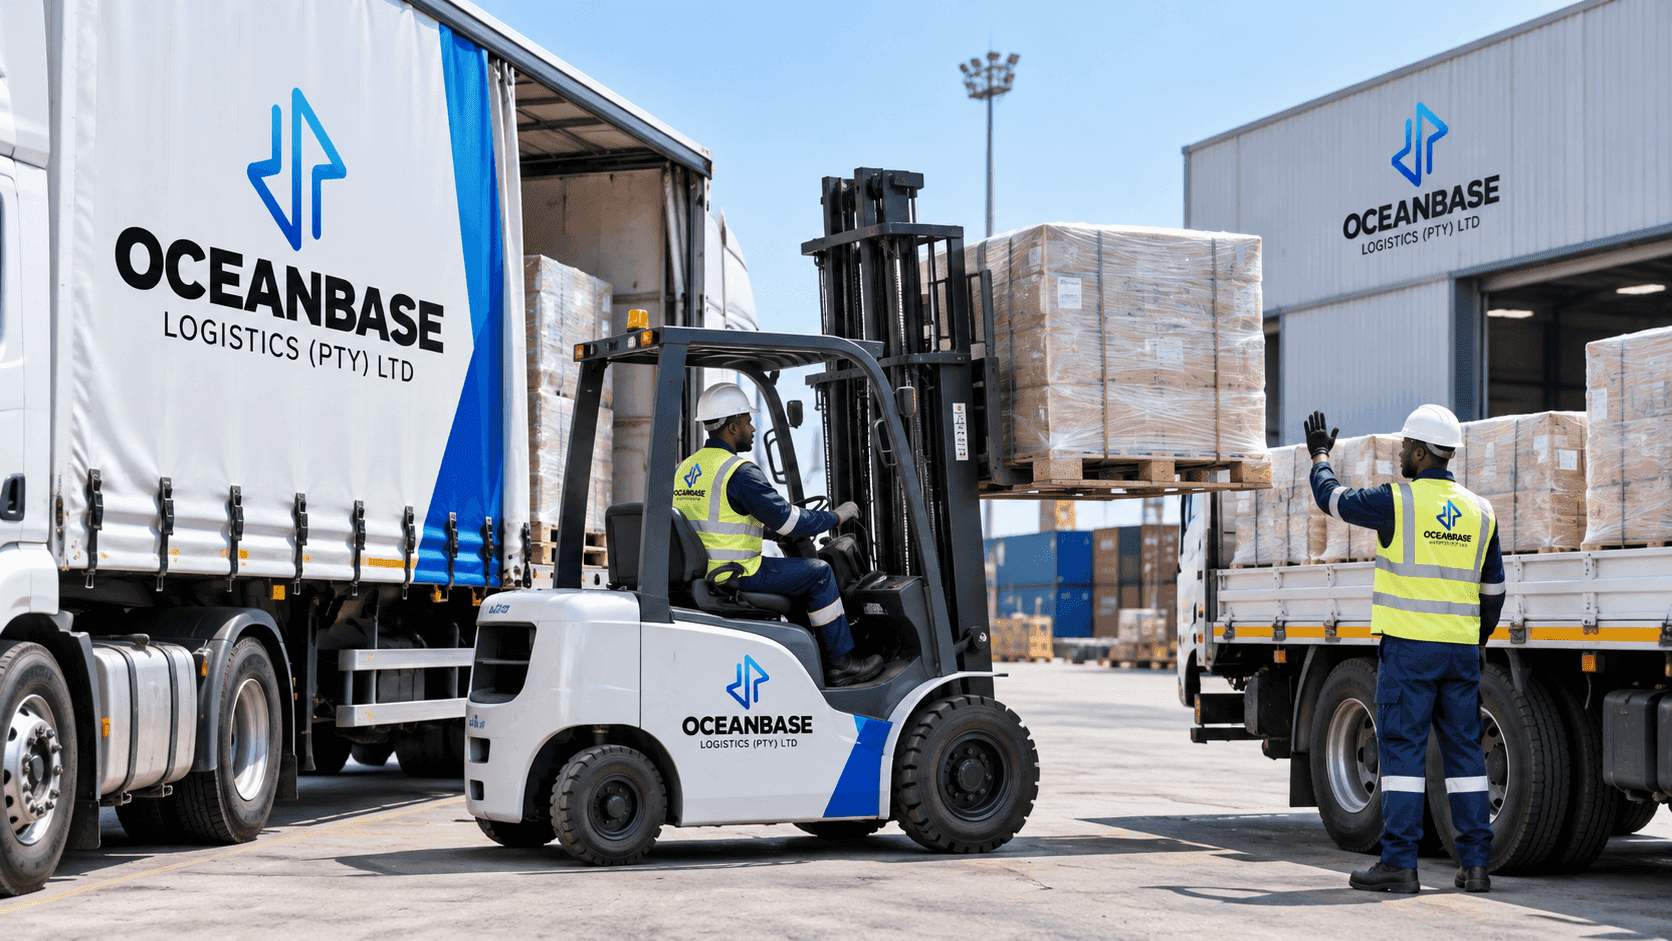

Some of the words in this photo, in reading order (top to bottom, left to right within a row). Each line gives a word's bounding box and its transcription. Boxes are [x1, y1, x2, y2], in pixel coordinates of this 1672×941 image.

[1342, 175, 1500, 240] OCEANBASE
[1361, 230, 1419, 256] LOGISTICS
[1423, 223, 1454, 242] (PTY)
[1457, 215, 1480, 232] LTD
[114, 226, 444, 354] OCEANBASE
[163, 311, 299, 362] LOGISTICS
[309, 339, 369, 377] (PTY)
[378, 354, 414, 382] LTD
[682, 715, 813, 736] OCEANBASE
[700, 739, 750, 749] LOGISTICS
[752, 738, 778, 749] (PTY)
[780, 738, 798, 748] LTD
